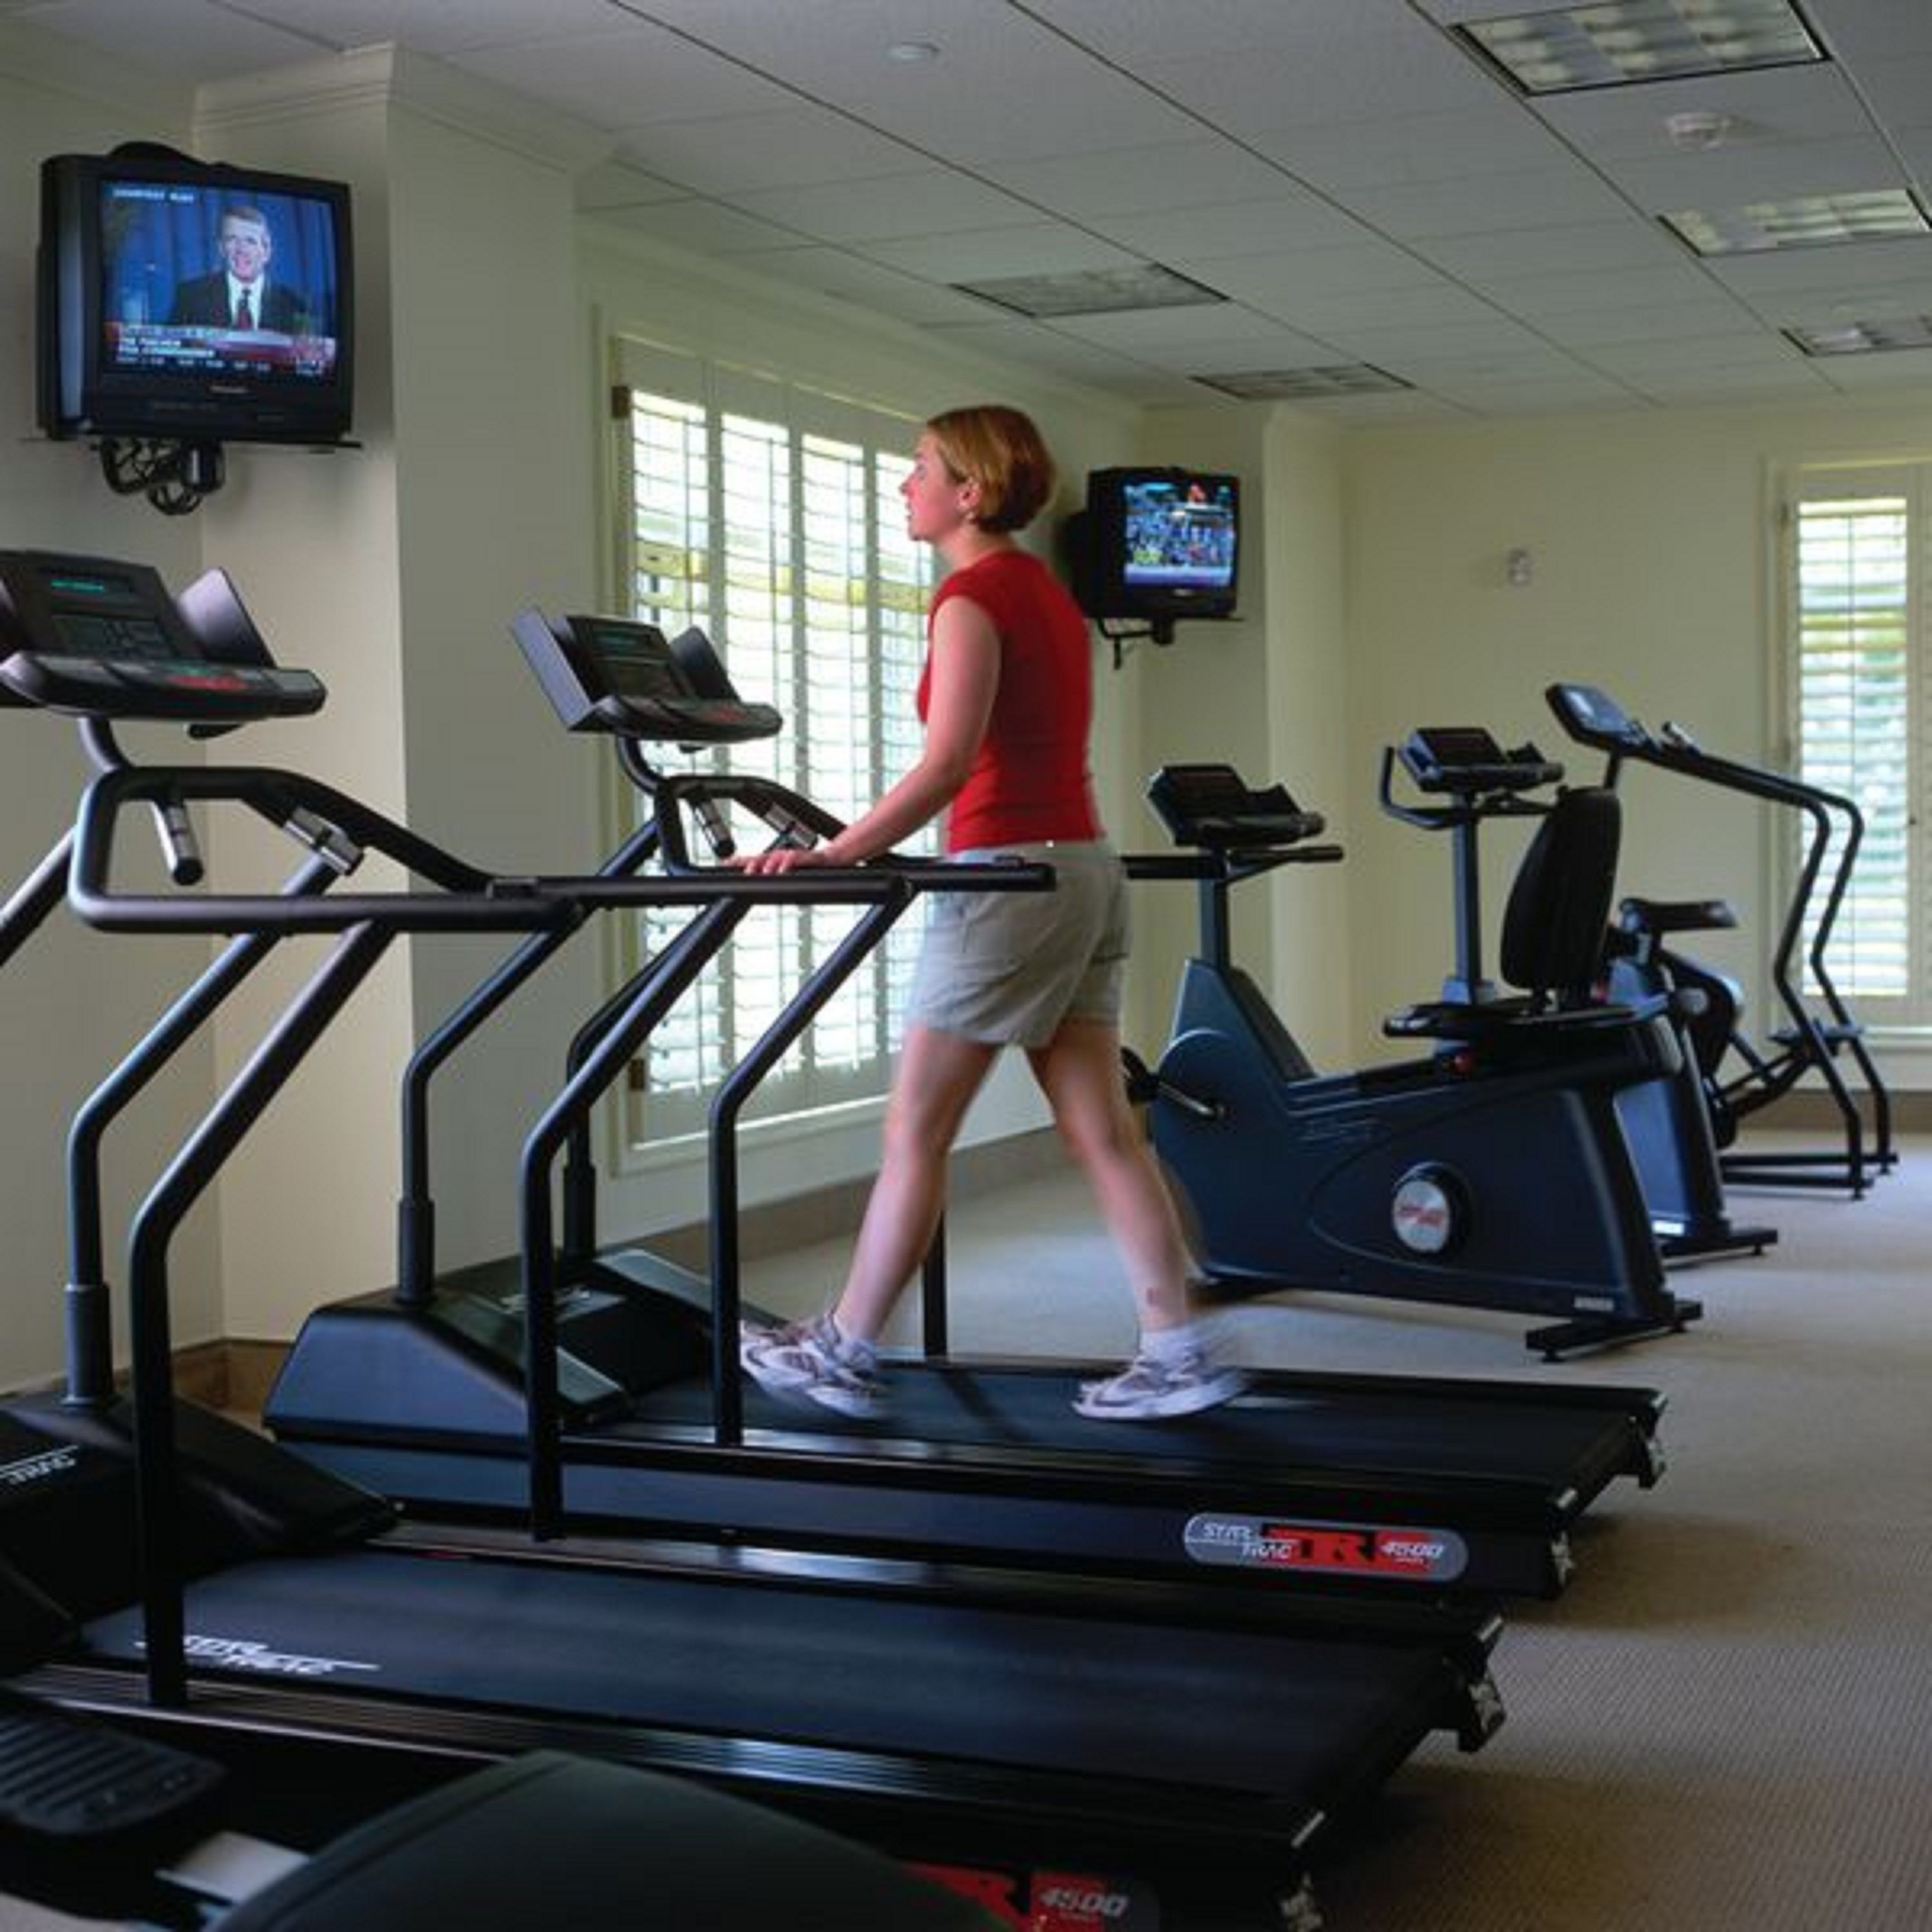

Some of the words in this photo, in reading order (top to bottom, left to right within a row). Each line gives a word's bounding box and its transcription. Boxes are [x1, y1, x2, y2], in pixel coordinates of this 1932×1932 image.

[1203, 1522, 1251, 1540] STAR
[1381, 1540, 1444, 1559] 4500
[1039, 1886, 1128, 1918] 4500
